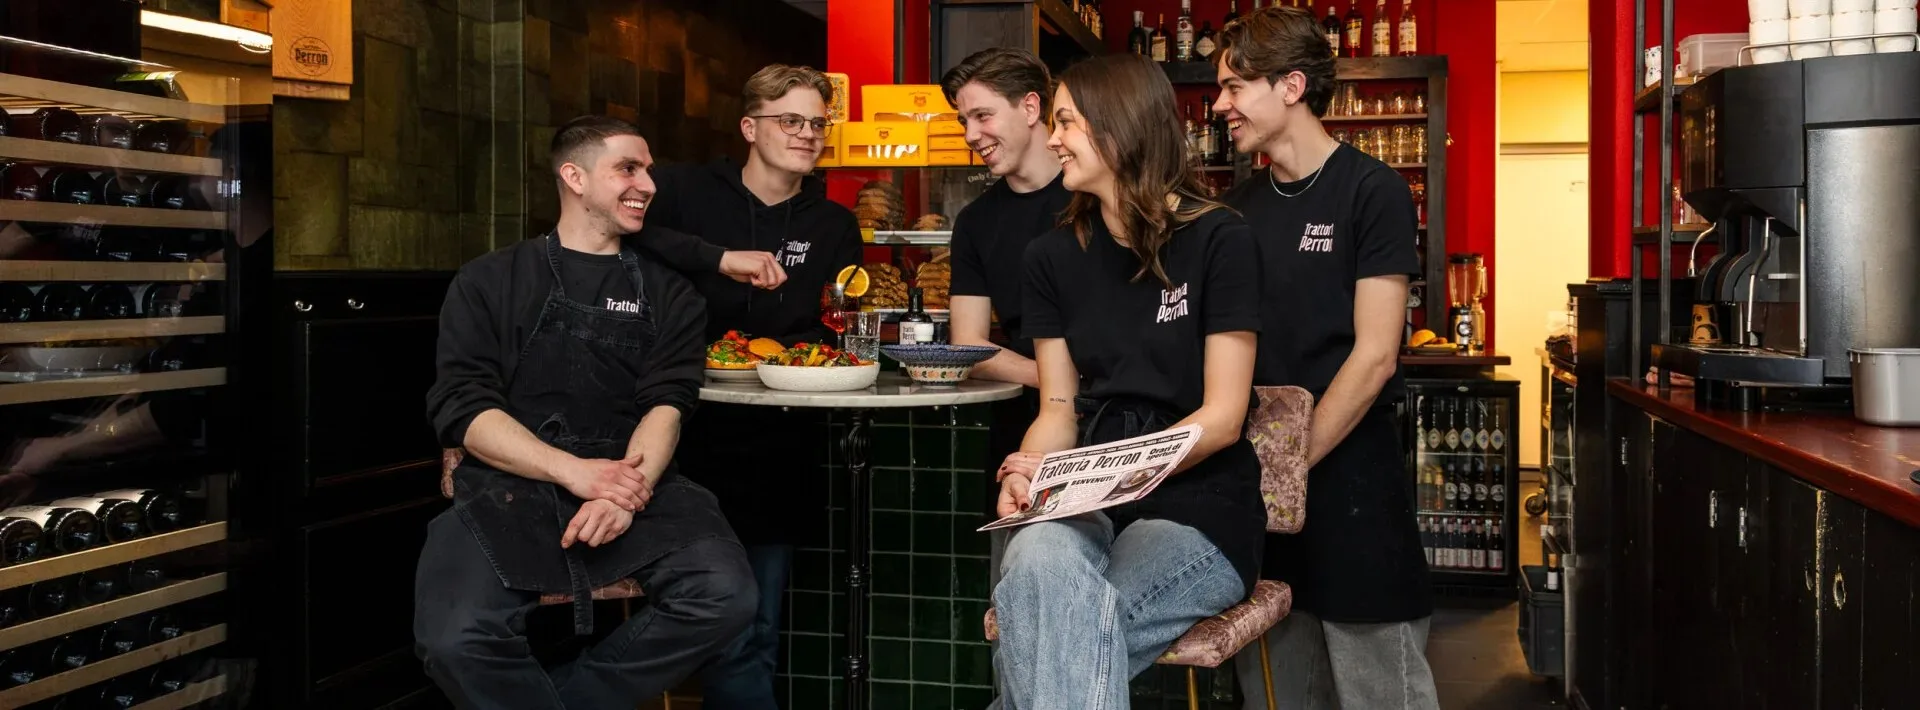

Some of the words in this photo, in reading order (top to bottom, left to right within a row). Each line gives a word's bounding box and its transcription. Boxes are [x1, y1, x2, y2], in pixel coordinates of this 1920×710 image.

[295, 48, 328, 65] Perron
[1149, 445, 1172, 455] Orari
[1172, 442, 1183, 451] di
[1037, 458, 1091, 483] Trattoria
[1092, 451, 1142, 470] Perron
[1070, 475, 1117, 486] BENVENUTI!
